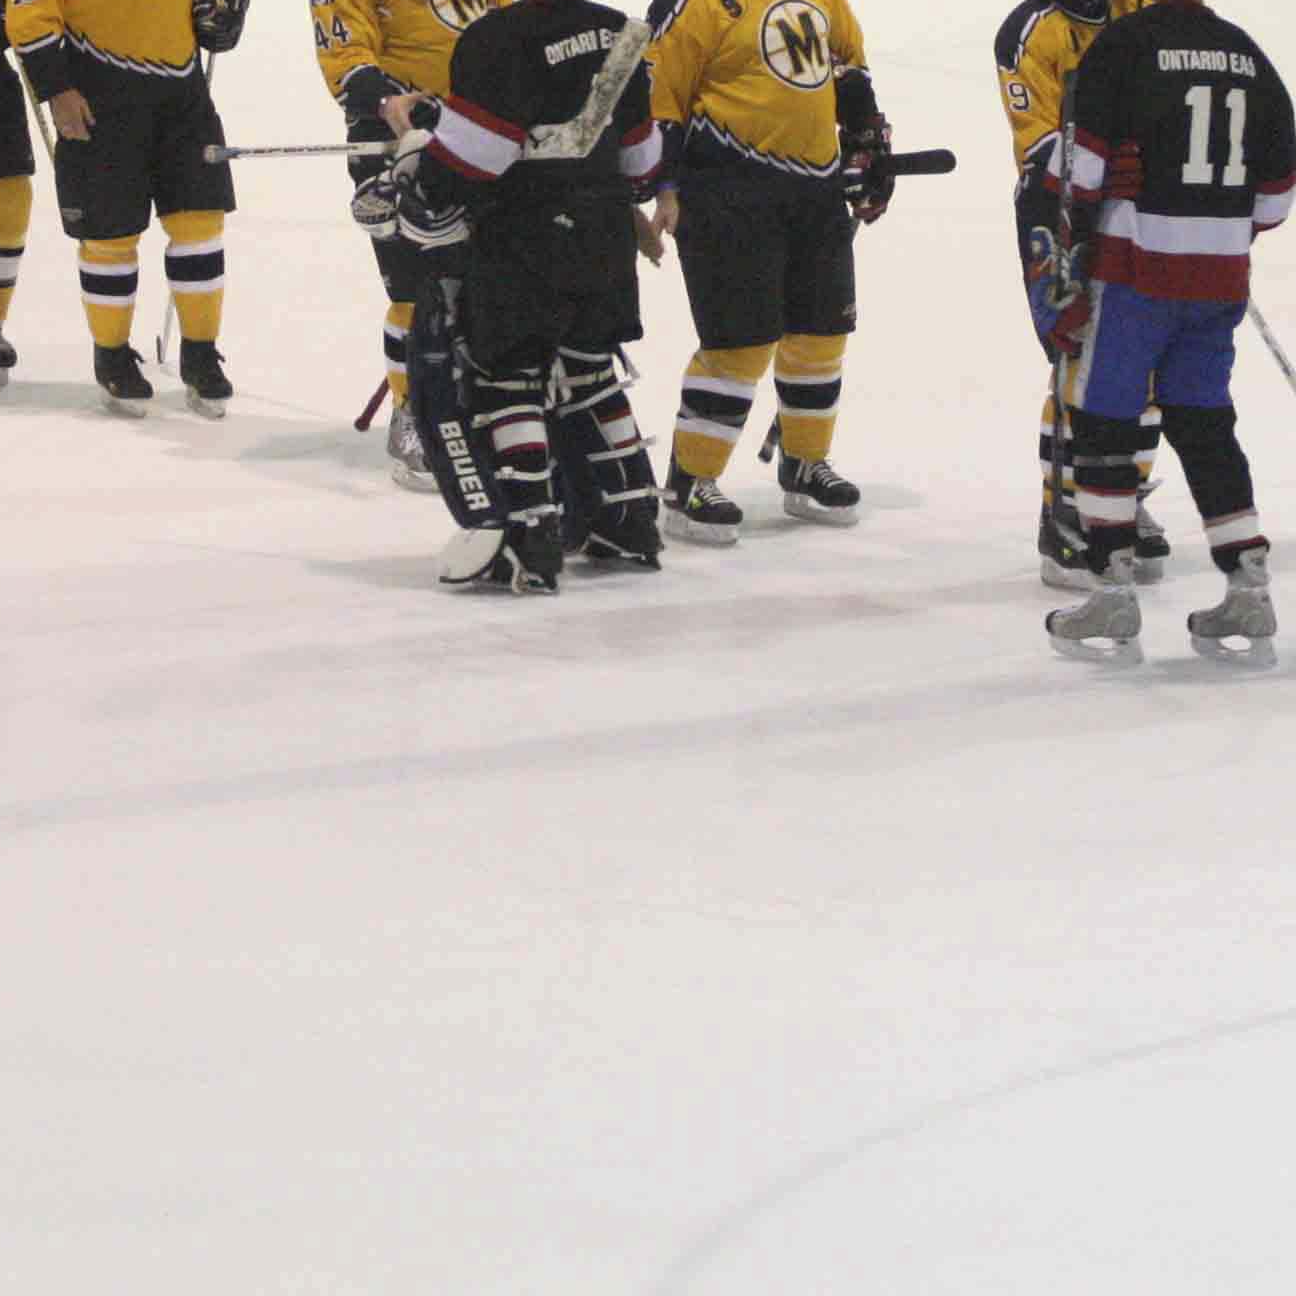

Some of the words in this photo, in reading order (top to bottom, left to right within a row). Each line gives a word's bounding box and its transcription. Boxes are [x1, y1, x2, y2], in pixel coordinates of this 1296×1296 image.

[313, 14, 351, 49] 44
[775, 10, 826, 76] M
[1157, 49, 1227, 71] ONTARIO
[1181, 85, 1248, 187] 11
[437, 420, 491, 511] BAUER
